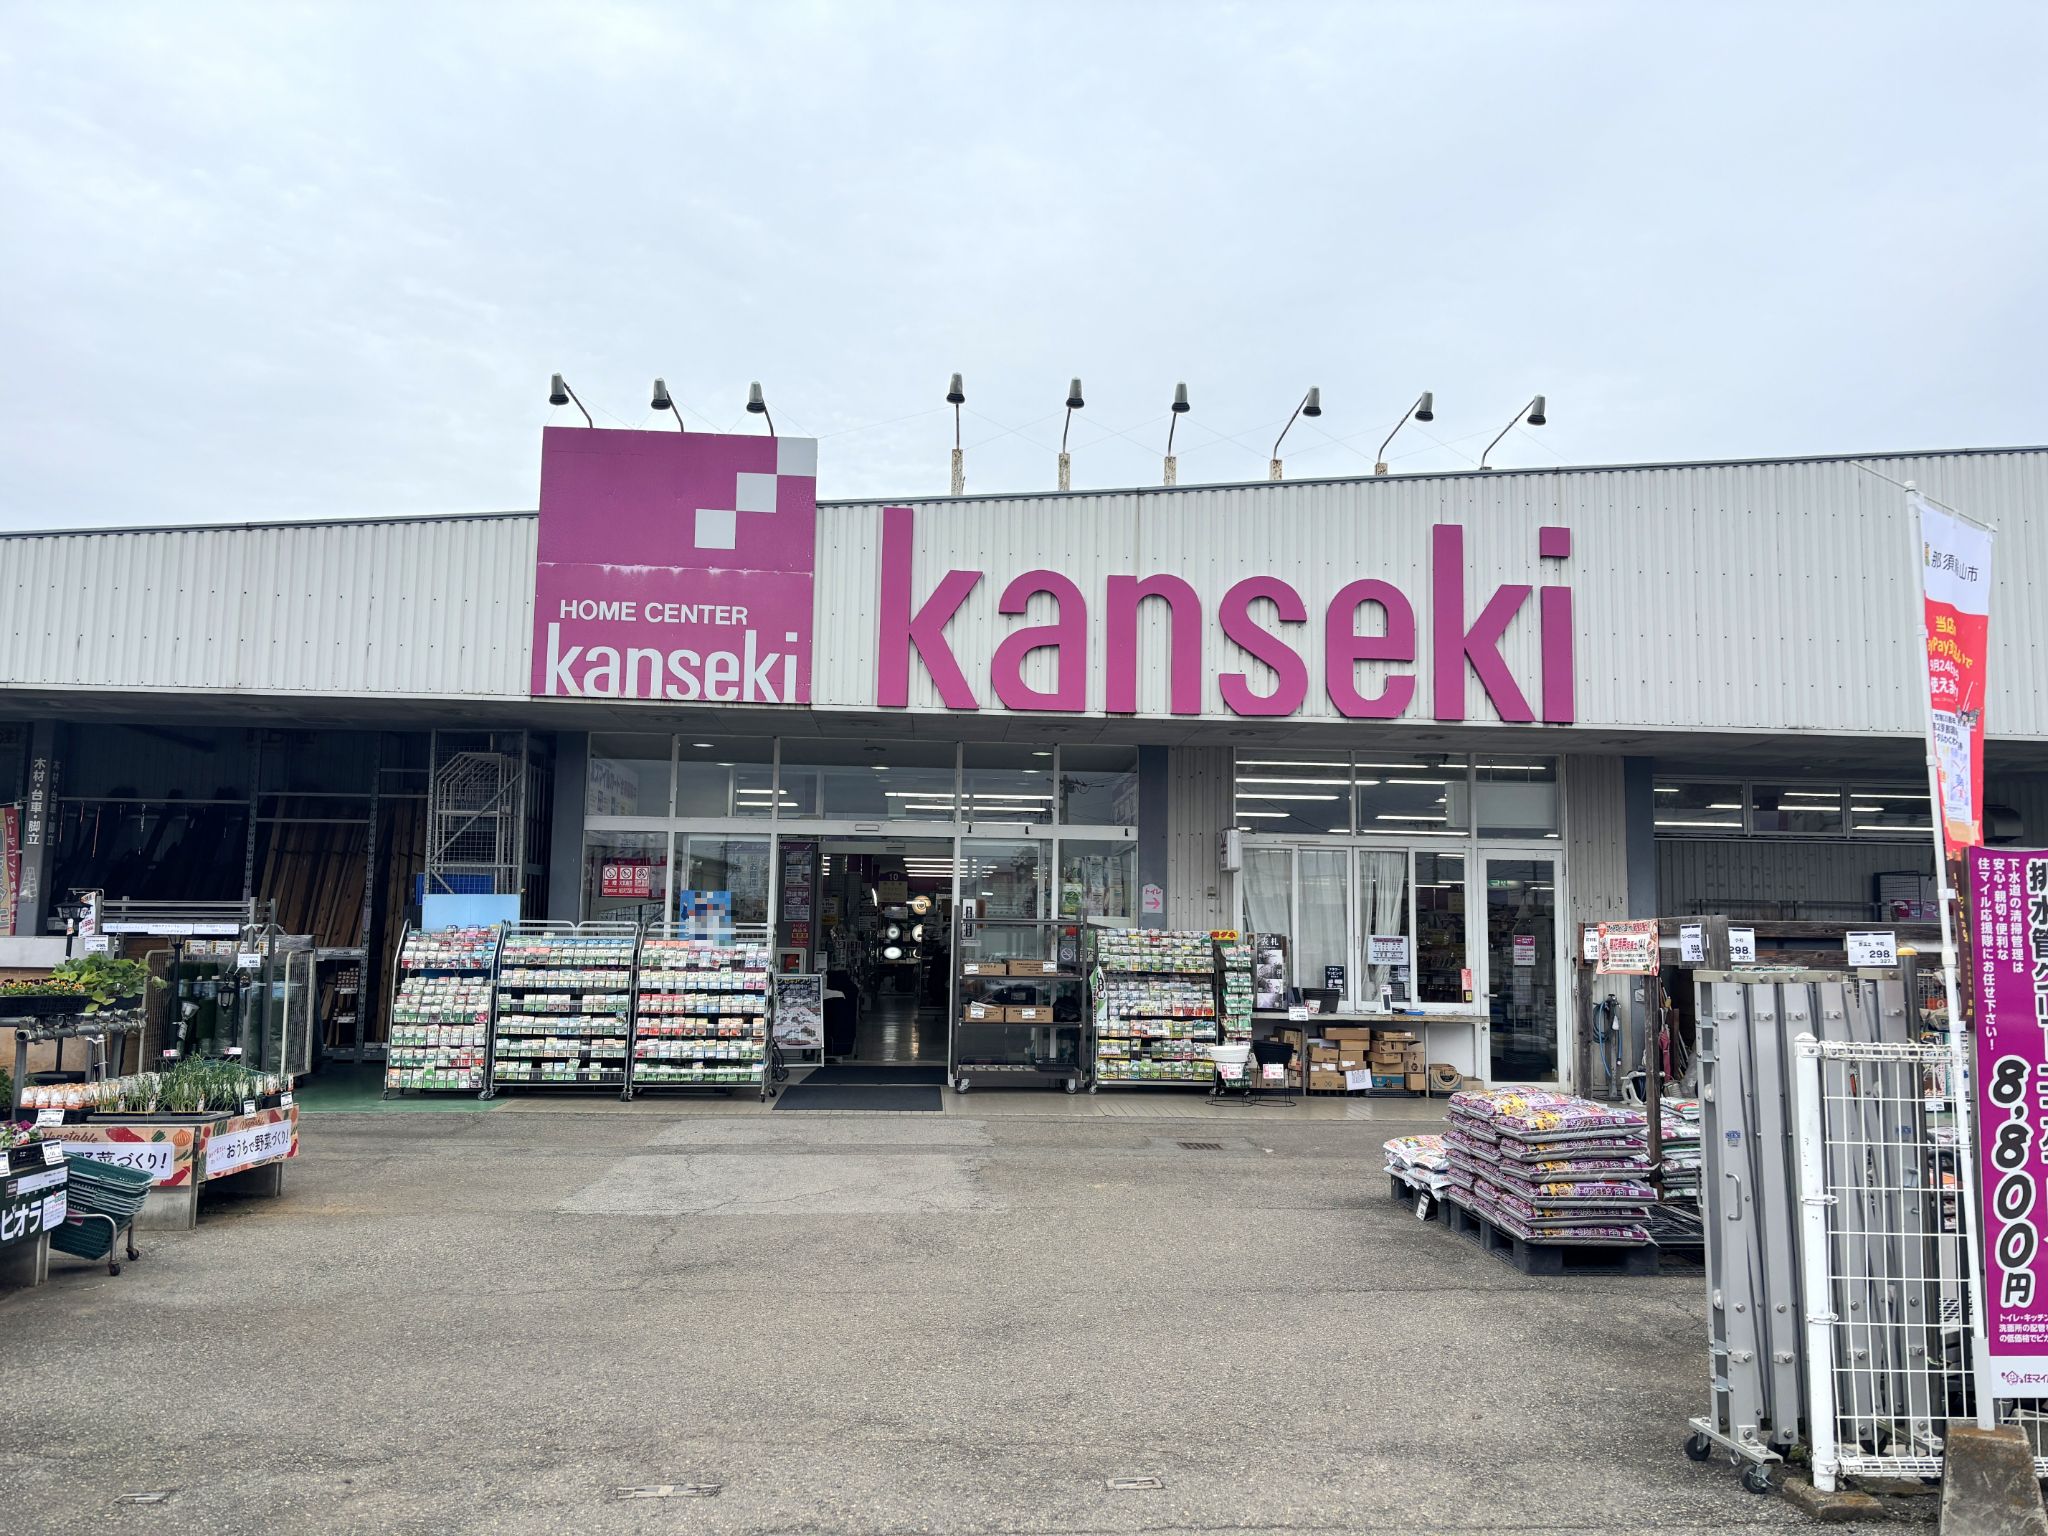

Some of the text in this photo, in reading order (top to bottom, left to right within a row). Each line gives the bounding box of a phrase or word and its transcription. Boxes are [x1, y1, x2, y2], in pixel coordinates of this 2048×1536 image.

[559, 599, 748, 626] HOME CENTER
[877, 507, 1574, 723] kanseki
[545, 622, 798, 704] kanseki
[26, 757, 47, 845] 木材・台車・脚立
[1144, 887, 1162, 896] トイレ
[1993, 857, 2009, 961] 安心・親切・便利な
[2008, 857, 2025, 974] 下水道の清掃管理は
[1729, 946, 1749, 955] 298
[1869, 949, 1891, 959] 298
[226, 1129, 290, 1159] おうちで野菜づくり!
[1991, 1056, 2037, 1306] 8,800円
[1, 1200, 43, 1241] ビオラ
[1999, 1323, 2048, 1333] 洗面所の配管
